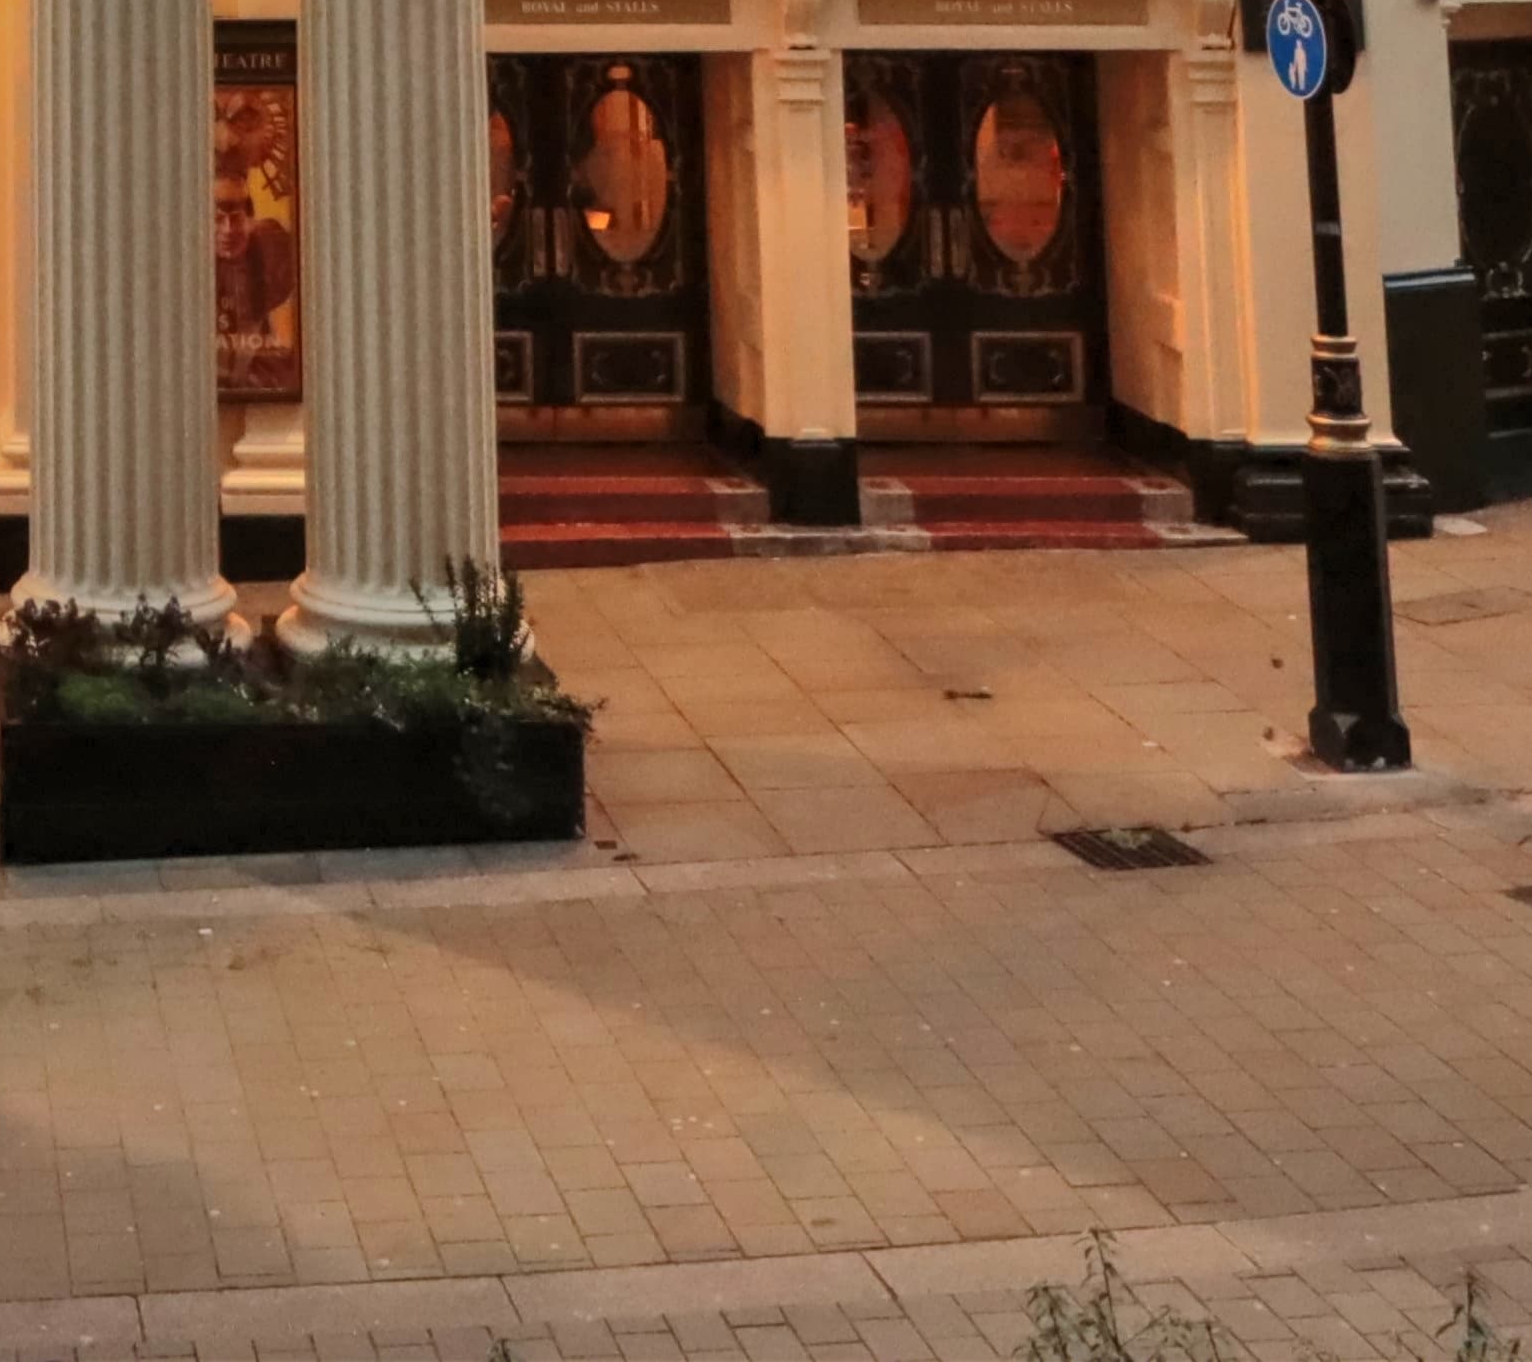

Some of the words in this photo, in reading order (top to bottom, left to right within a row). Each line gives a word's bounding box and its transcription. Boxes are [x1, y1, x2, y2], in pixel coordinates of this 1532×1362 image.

[521, 1, 566, 13] ROYAL
[575, 2, 598, 13] and
[605, 0, 660, 13] STALLS
[215, 52, 286, 69] EATRE
[217, 335, 282, 350] ATION
